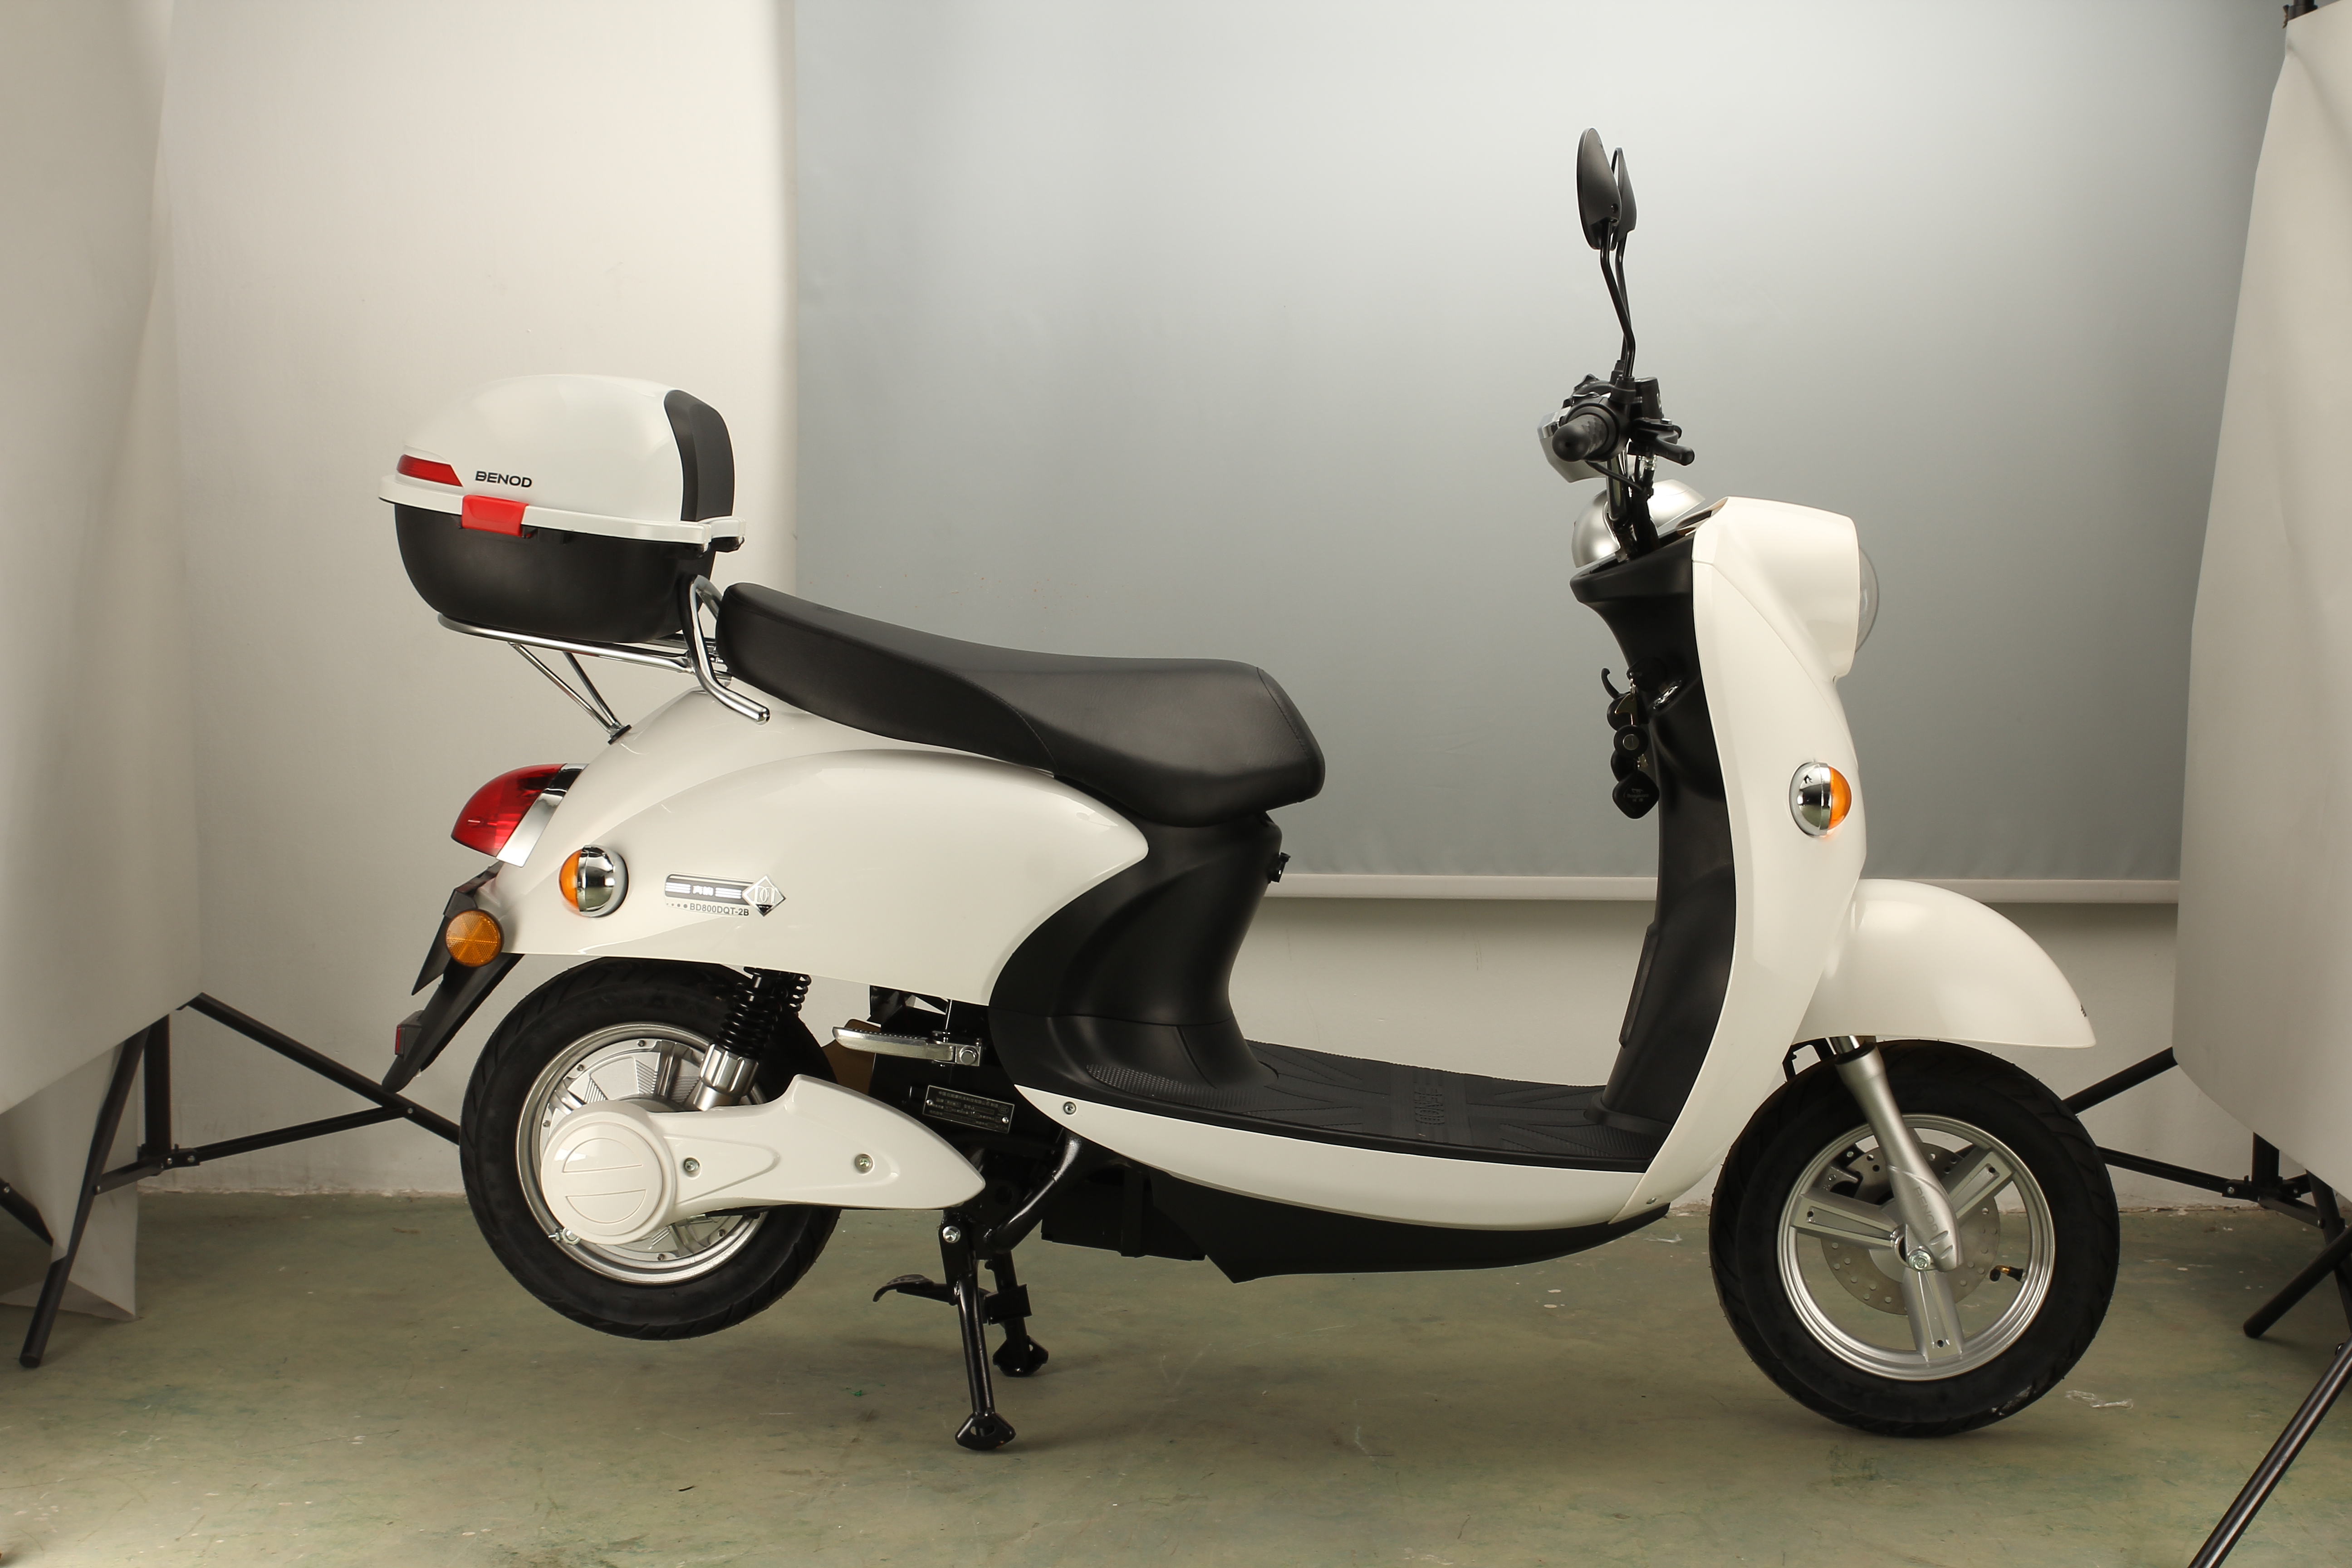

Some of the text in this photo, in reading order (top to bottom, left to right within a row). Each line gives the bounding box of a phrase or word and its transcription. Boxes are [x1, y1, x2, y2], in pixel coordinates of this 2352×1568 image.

[475, 470, 532, 488] BENOD
[690, 903, 749, 916] BD800DQT-2B
[1913, 1186, 1938, 1233] BENOD
